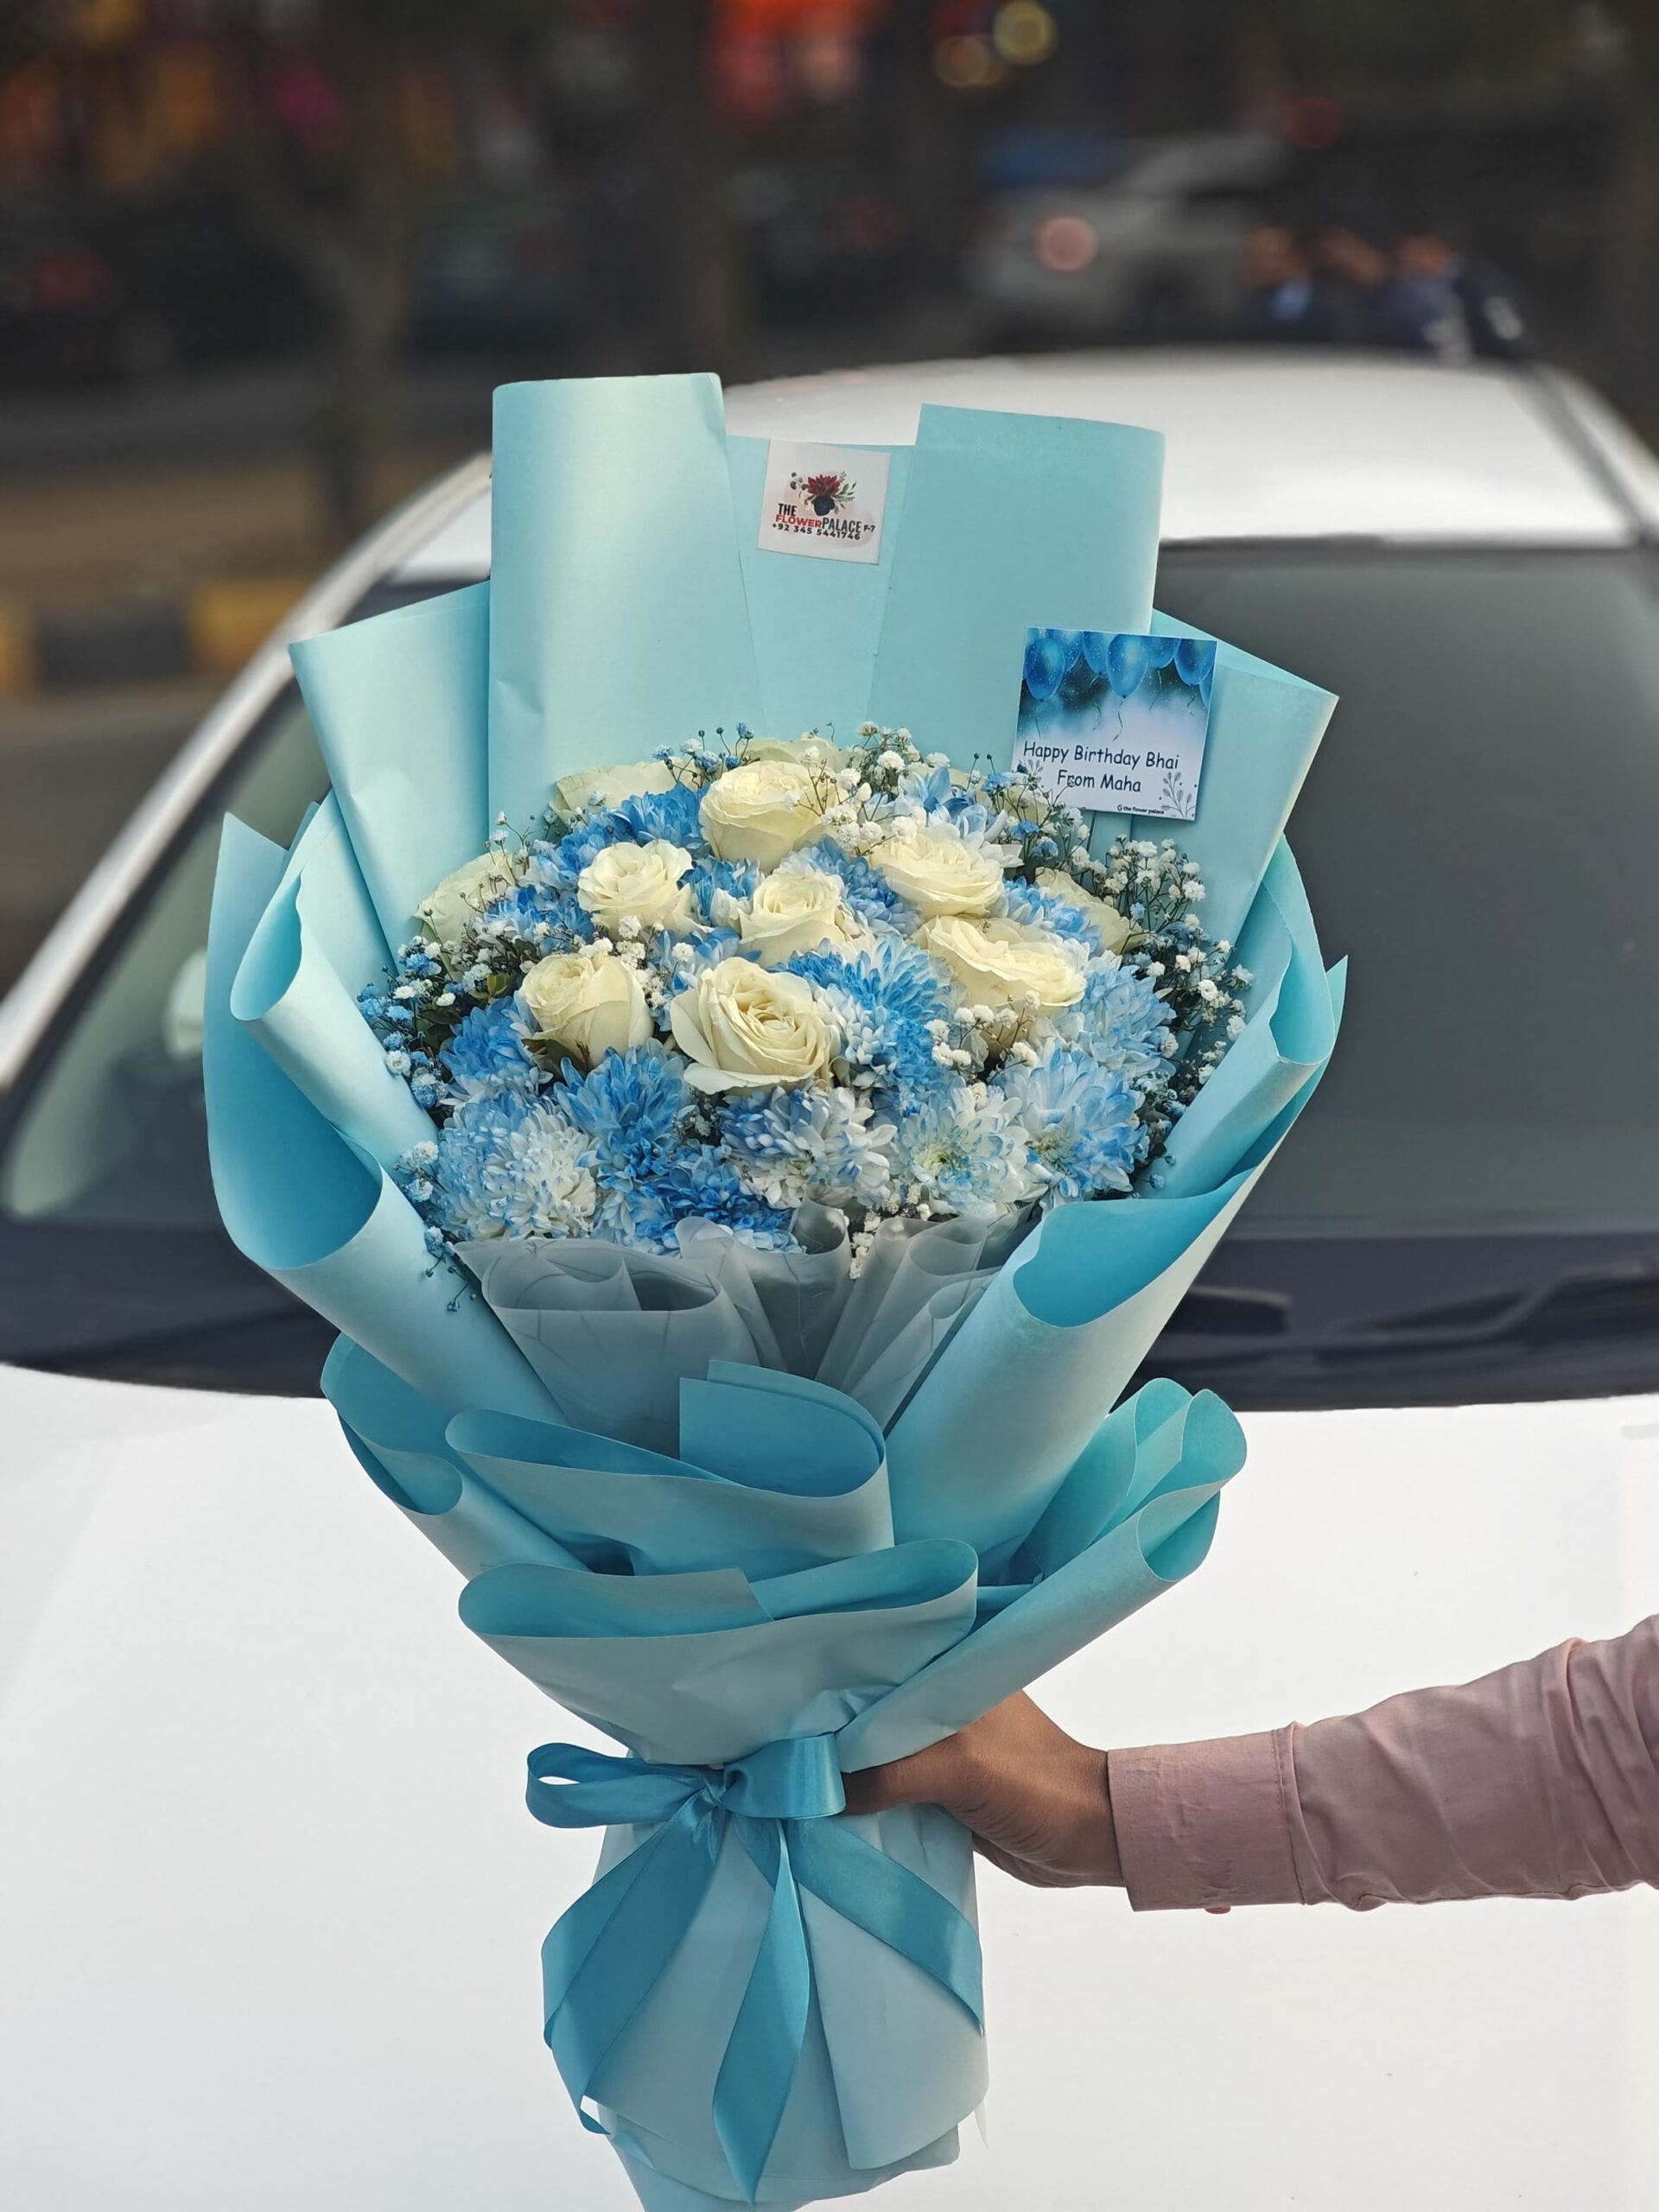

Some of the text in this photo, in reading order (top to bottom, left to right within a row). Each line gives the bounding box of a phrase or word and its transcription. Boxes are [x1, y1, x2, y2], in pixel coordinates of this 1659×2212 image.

[779, 503, 797, 517] THE
[772, 523, 861, 541] +92 345 5441746
[864, 524, 876, 533] F-7
[1023, 741, 1180, 771] Happy Birthday Bhai
[1057, 769, 1141, 792] From Maha
